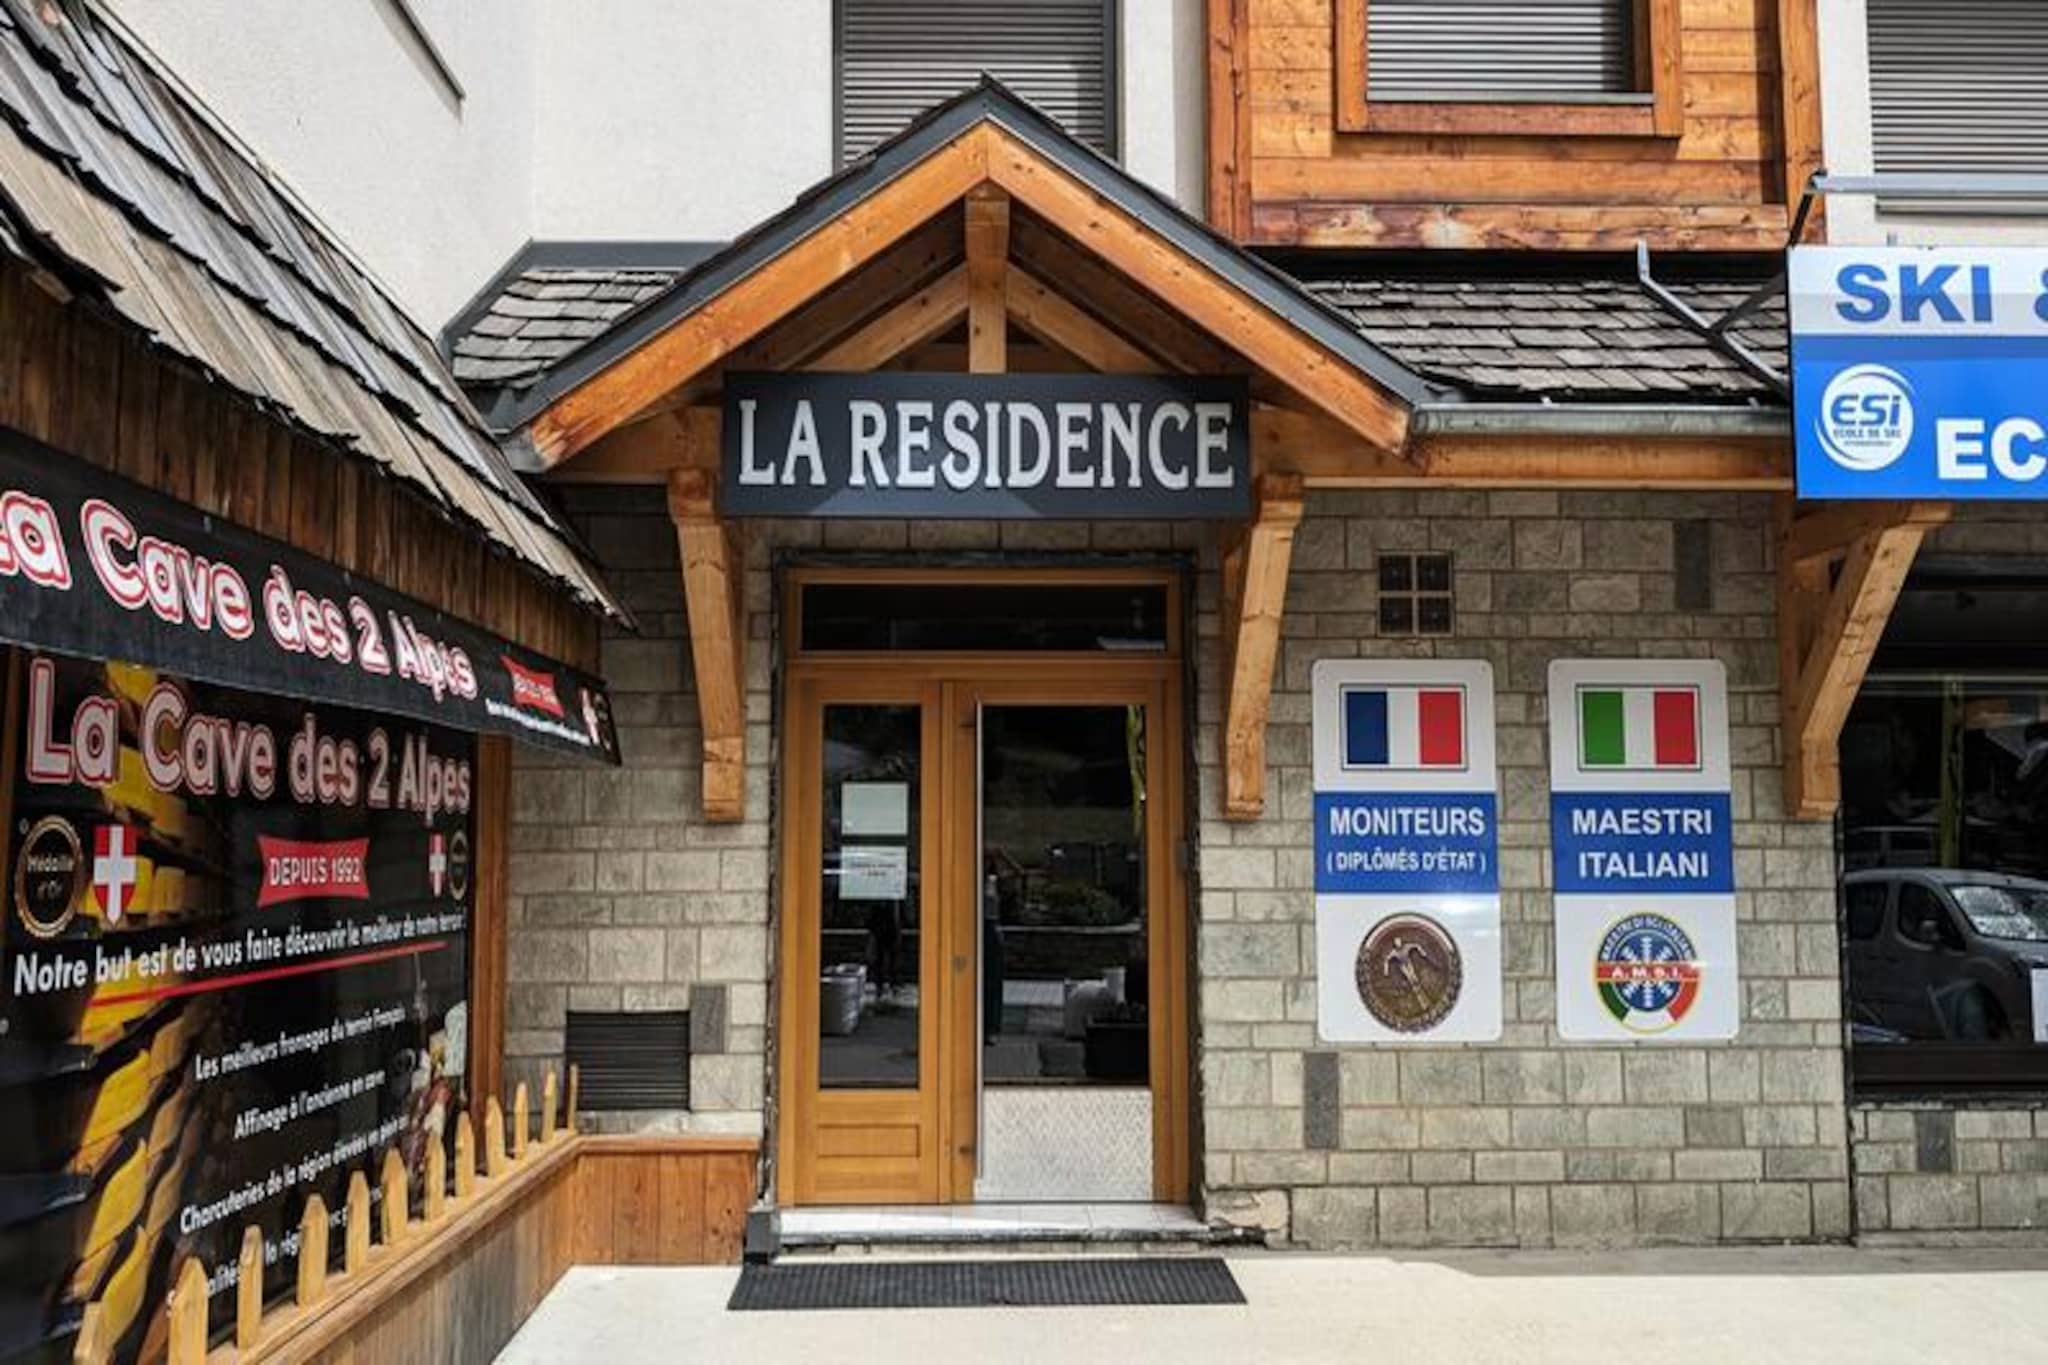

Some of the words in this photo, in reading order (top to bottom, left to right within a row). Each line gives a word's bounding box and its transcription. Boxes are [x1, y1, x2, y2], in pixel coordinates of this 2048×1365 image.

[1836, 264, 1992, 323] SKI
[738, 399, 828, 486] LA
[848, 400, 1236, 490] RESIDENCE
[0, 490, 72, 591] a
[81, 499, 254, 640] Cave
[263, 564, 353, 664] des
[349, 595, 392, 675] 2
[388, 609, 478, 704] Alpes
[26, 657, 119, 787] La
[142, 681, 277, 800] Cave
[288, 711, 360, 807] des
[367, 726, 391, 809] 2
[398, 728, 472, 828] Alpes
[1329, 806, 1486, 837] MONITEURS
[1572, 807, 1713, 836] MAESTRI
[269, 857, 327, 886] DEPUIS
[331, 856, 362, 884] 1992
[1578, 851, 1710, 879] ITALIANI
[14, 951, 89, 996] Notre
[95, 945, 132, 983] but
[136, 942, 168, 977] est
[172, 936, 197, 972] de
[201, 941, 243, 970] vous
[246, 928, 282, 963] faire
[284, 919, 348, 956] découvrir
[348, 917, 360, 947] le
[403, 911, 416, 938] de
[195, 1053, 220, 1081] Les
[220, 1041, 279, 1075] meilleurs
[279, 1030, 330, 1055] fromages
[331, 1017, 345, 1043] du
[233, 1106, 289, 1140] Affinage
[180, 1180, 266, 1234] Charcuteries
[266, 1169, 283, 1195] de
[283, 1162, 297, 1187] la
[298, 1150, 332, 1183] région
